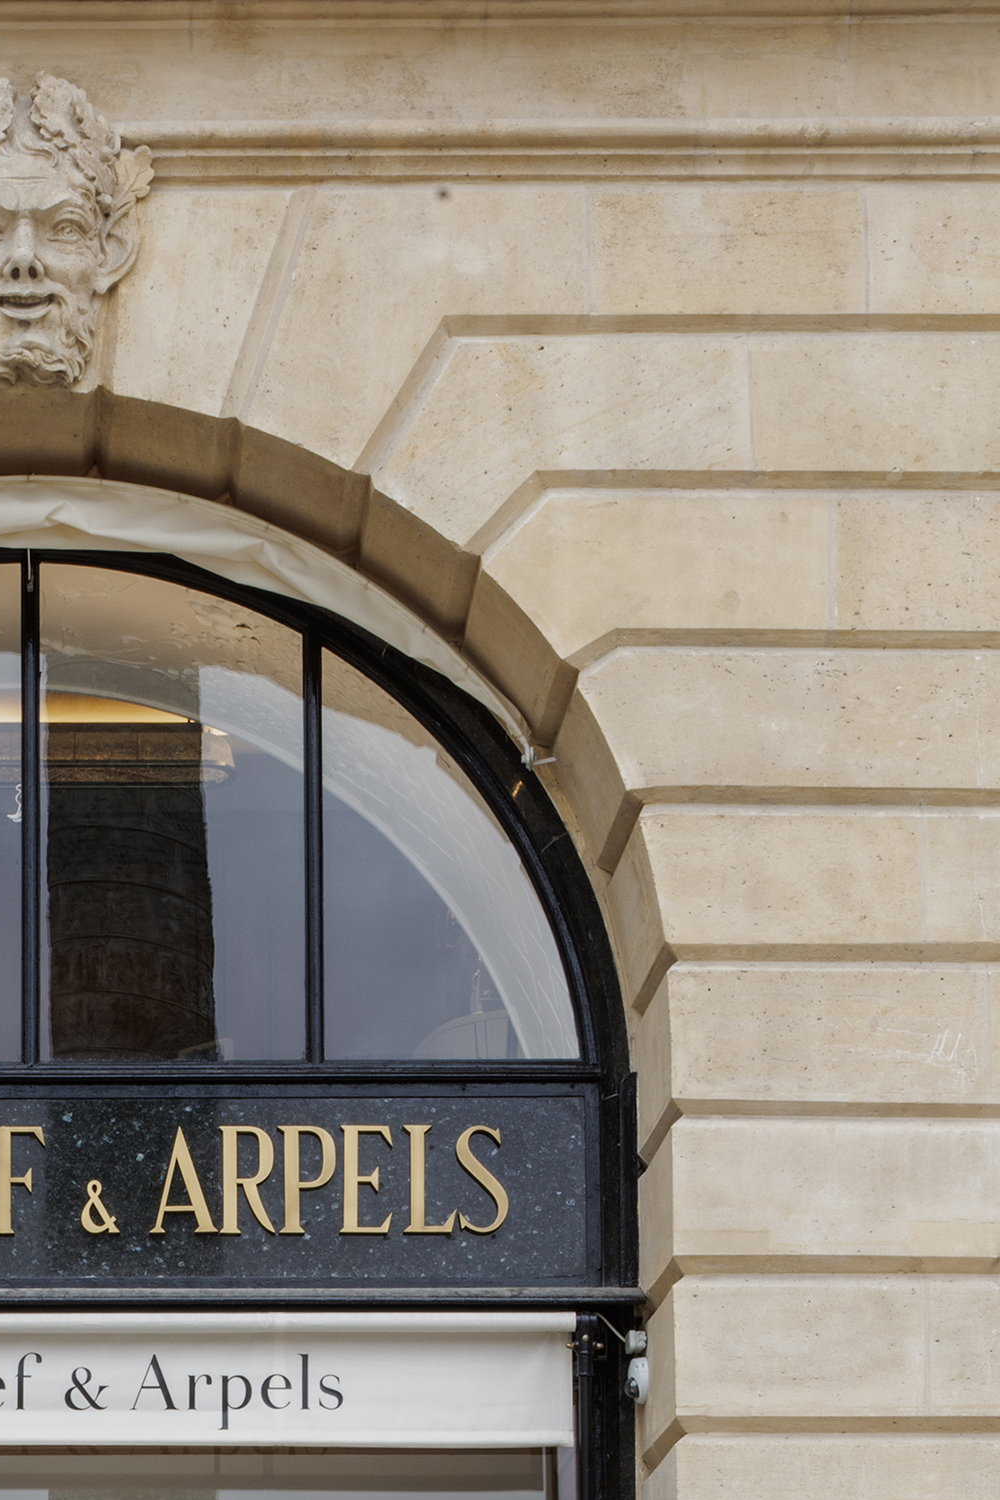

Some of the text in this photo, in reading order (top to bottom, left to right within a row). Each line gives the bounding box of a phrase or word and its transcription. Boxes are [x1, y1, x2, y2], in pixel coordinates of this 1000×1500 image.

[80, 1179, 121, 1235] &
[149, 1124, 510, 1236] ARPELS
[63, 1366, 111, 1412] &
[129, 1352, 344, 1431] Arpels
